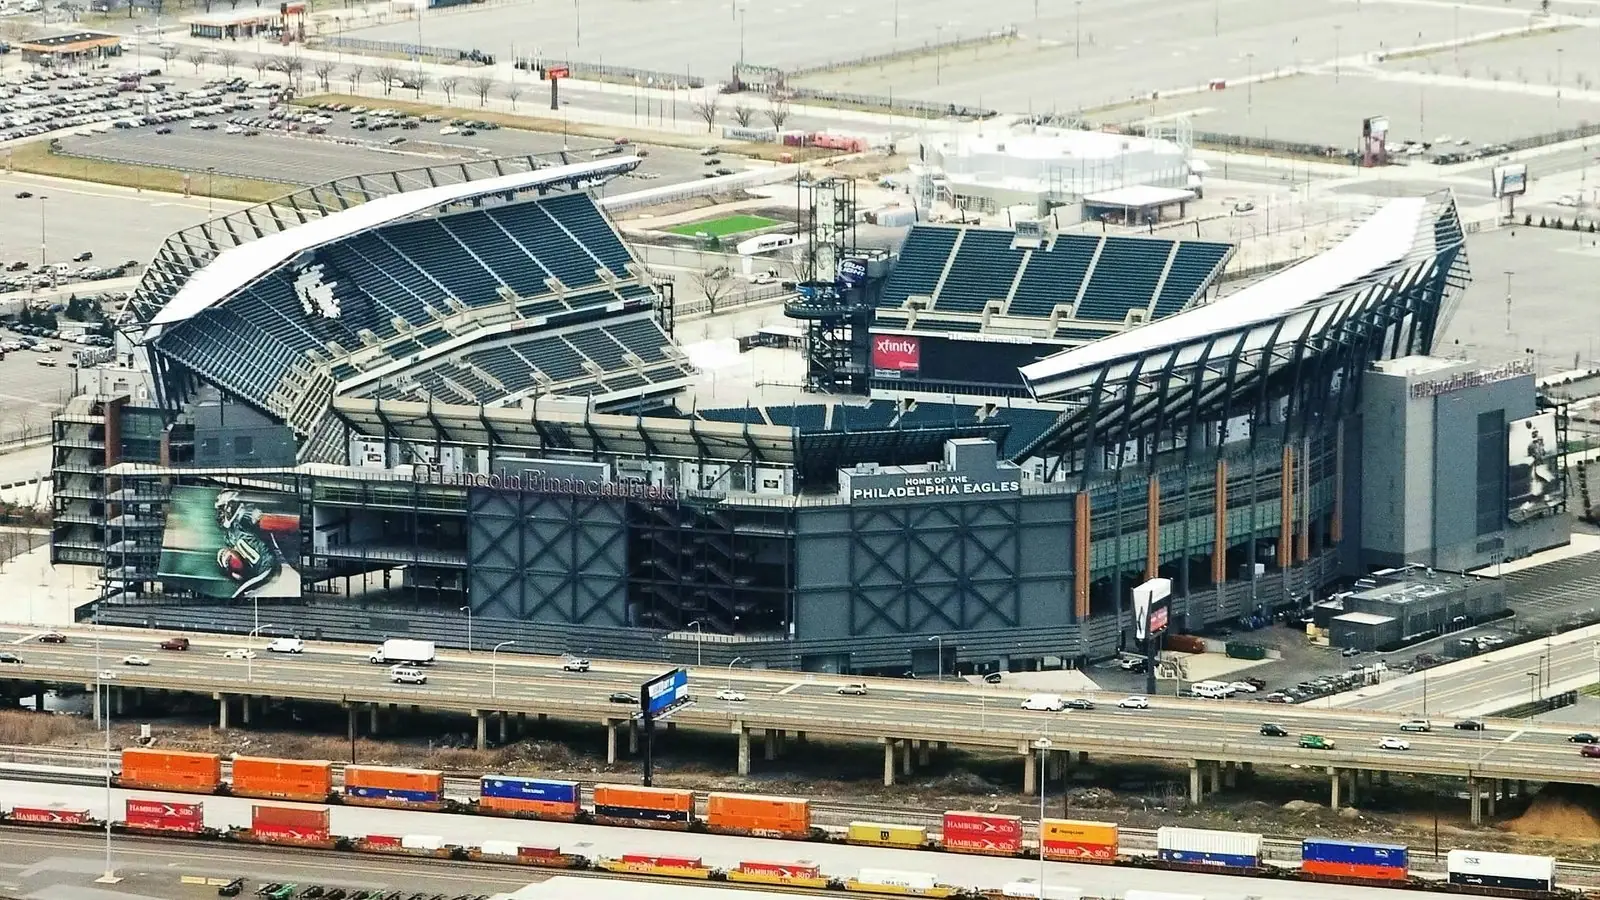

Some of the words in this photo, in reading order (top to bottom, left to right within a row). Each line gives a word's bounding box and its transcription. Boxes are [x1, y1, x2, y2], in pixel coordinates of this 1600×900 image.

[843, 261, 866, 272] BUD
[877, 339, 916, 355] xfinity
[438, 464, 521, 490] Lincoln
[523, 468, 628, 496] Financial
[626, 476, 678, 500] Field
[905, 477, 932, 486] HOME
[949, 475, 968, 483] THE
[853, 484, 959, 499] PHILADELPHIA
[963, 481, 1019, 493] EAGLES
[129, 803, 163, 814] HAMBURG
[15, 811, 50, 821] HAMBURG
[947, 820, 983, 831] HAMBURG
[255, 829, 290, 838] HAMBURG
[947, 838, 983, 847] HAMBURG
[1042, 846, 1079, 856] HAMBURG
[743, 867, 780, 877] HAMBURG
